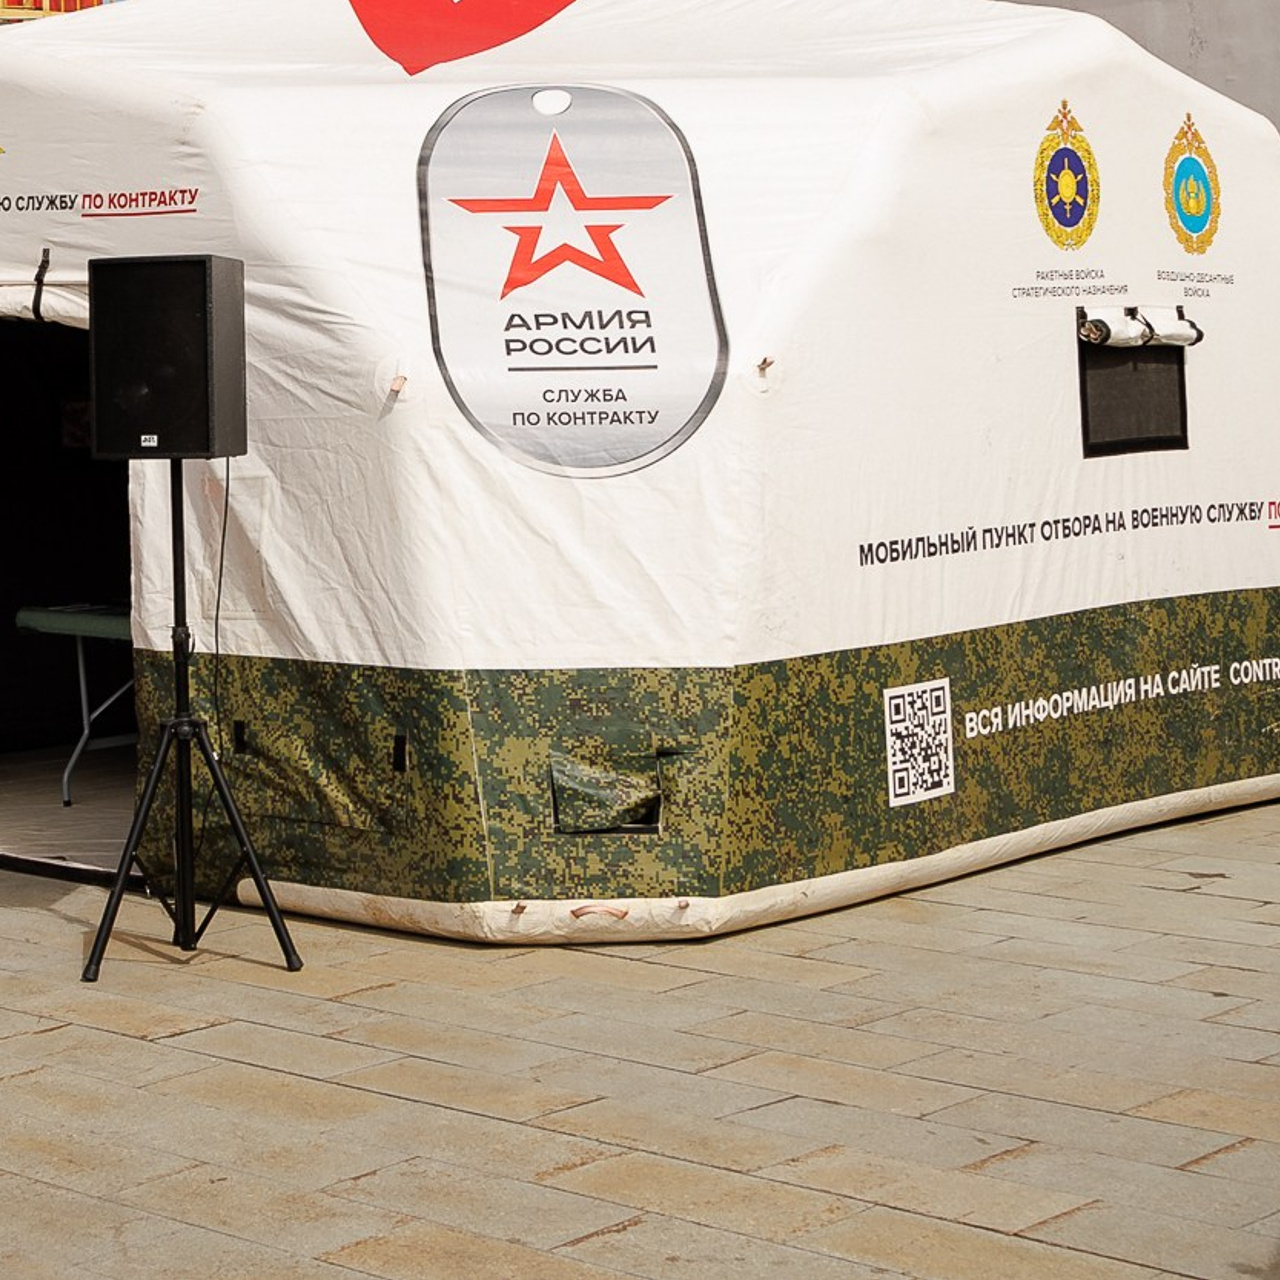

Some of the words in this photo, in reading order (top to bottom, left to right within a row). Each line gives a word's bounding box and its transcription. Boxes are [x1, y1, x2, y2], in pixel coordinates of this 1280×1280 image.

[15, 194, 79, 213] СЛУЖБУ
[81, 192, 104, 210] ПО
[107, 188, 200, 210] КОНТРАКТУ
[1036, 270, 1073, 280] РАКЕТНЫЕ
[1075, 268, 1105, 280] ВОЙСКА
[1183, 286, 1210, 298] ВОЙСКА
[503, 309, 653, 333] АРМИЯ
[504, 336, 657, 357] РОССИИ
[541, 388, 628, 404] СЛУЖБА
[512, 411, 542, 427] ПО
[545, 409, 661, 426] КОНТРАКТУ
[859, 525, 978, 567] МОБИЛЬНЫЙ
[982, 522, 1036, 550] ПУНКТ
[1040, 514, 1103, 542] ОТБОРА
[1105, 511, 1127, 533] НА
[1130, 505, 1203, 530] ВОЕННУЮ
[1206, 501, 1265, 524] СЛУЖБУ
[964, 708, 1003, 739] ВСЯ
[1006, 679, 1136, 729] ИНФОРМАЦИЯ
[1140, 677, 1164, 701] НА
[1167, 663, 1221, 695] САЙТЕ
